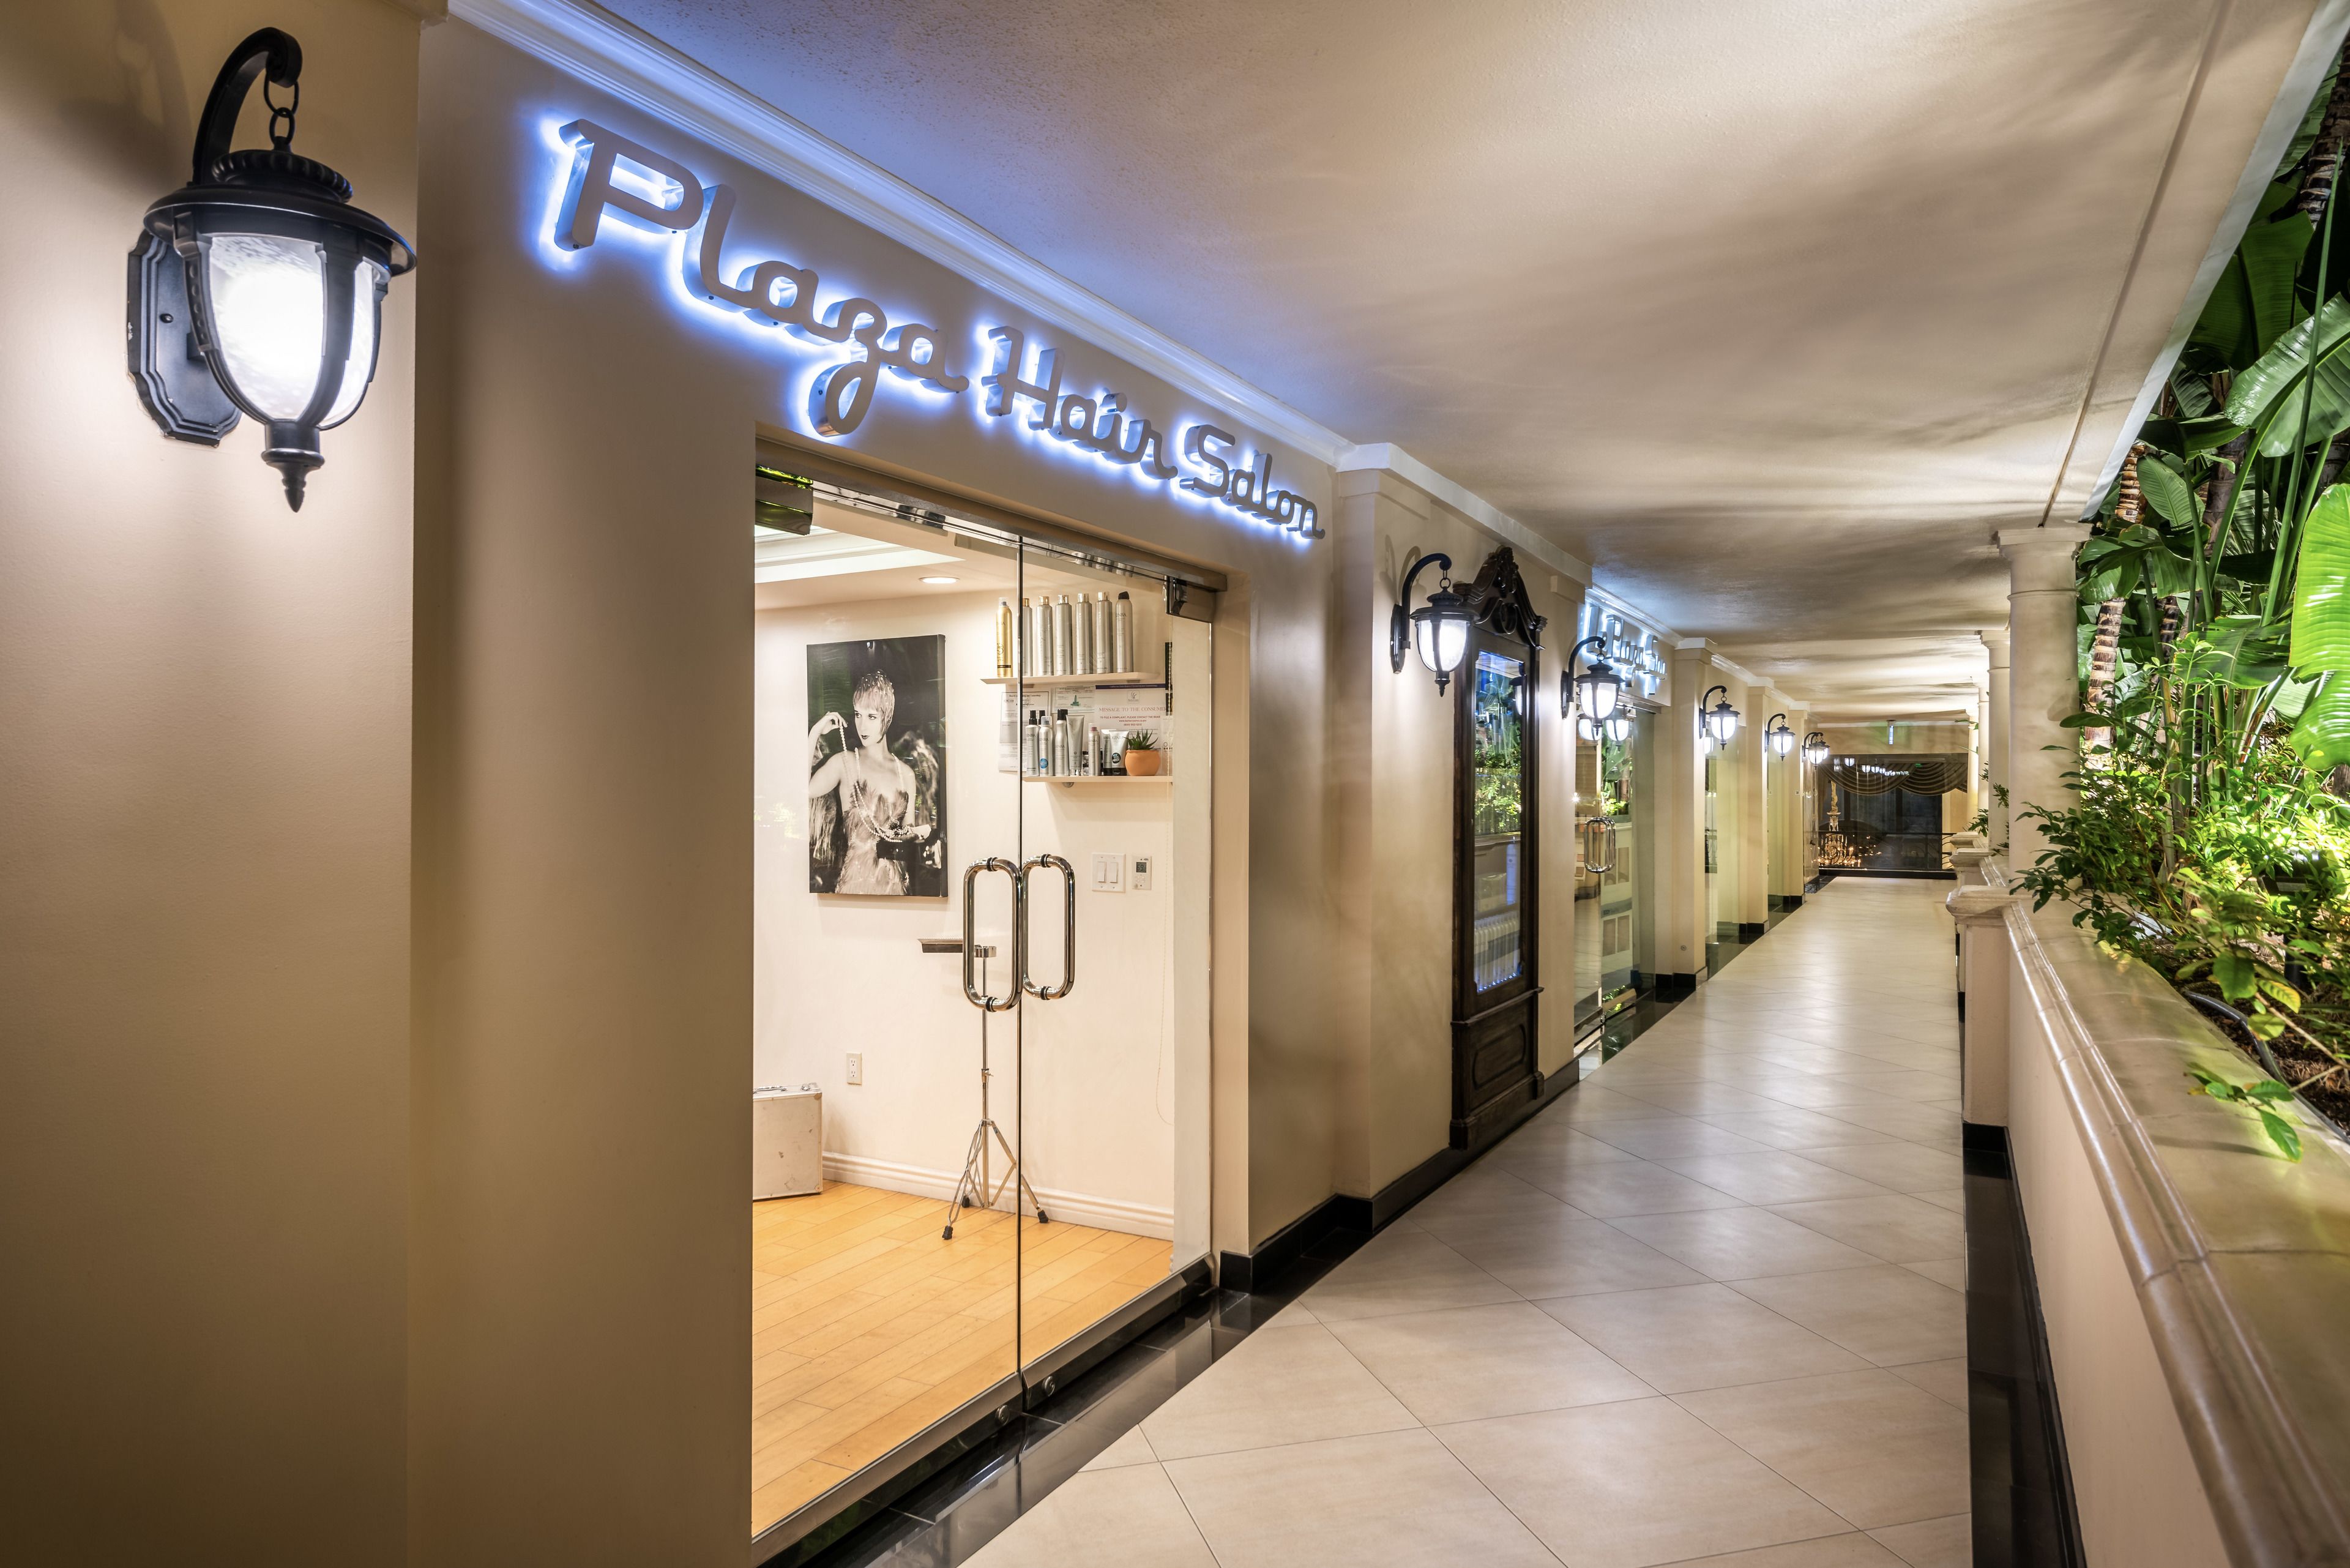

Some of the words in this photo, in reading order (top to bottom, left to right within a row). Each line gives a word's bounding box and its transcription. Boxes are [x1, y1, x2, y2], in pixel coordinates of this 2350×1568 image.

[554, 118, 970, 438] Plaza
[981, 326, 1178, 480] Hair
[1179, 424, 1326, 540] Salon
